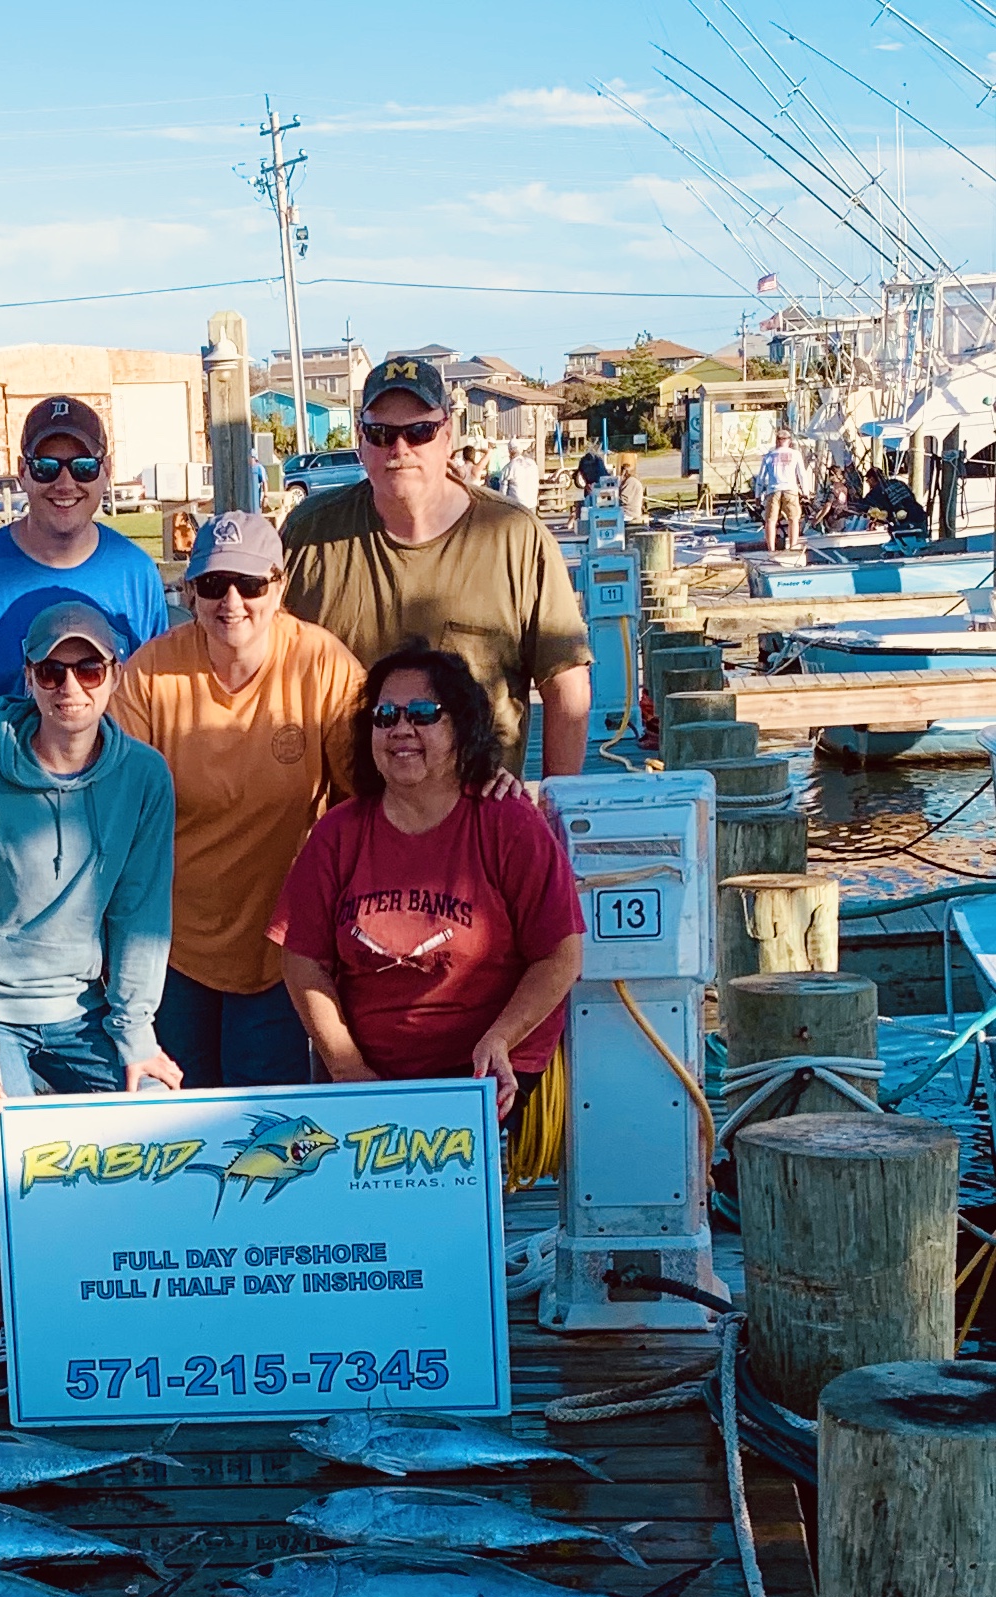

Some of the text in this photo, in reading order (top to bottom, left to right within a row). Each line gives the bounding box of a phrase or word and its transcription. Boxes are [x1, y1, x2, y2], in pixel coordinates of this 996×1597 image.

[385, 361, 419, 381] M
[51, 401, 70, 420] D
[607, 588, 617, 600] 11
[407, 888, 473, 929] BANKS
[612, 898, 646, 929] 13
[19, 1122, 476, 1200] RABID TUNA
[455, 1176, 478, 1186] NC
[112, 1243, 387, 1271] FULL DAY OFFSHORE
[81, 1270, 424, 1300] FULL / HALF DAY INSHORE
[65, 1349, 450, 1400] 571-215-7345
